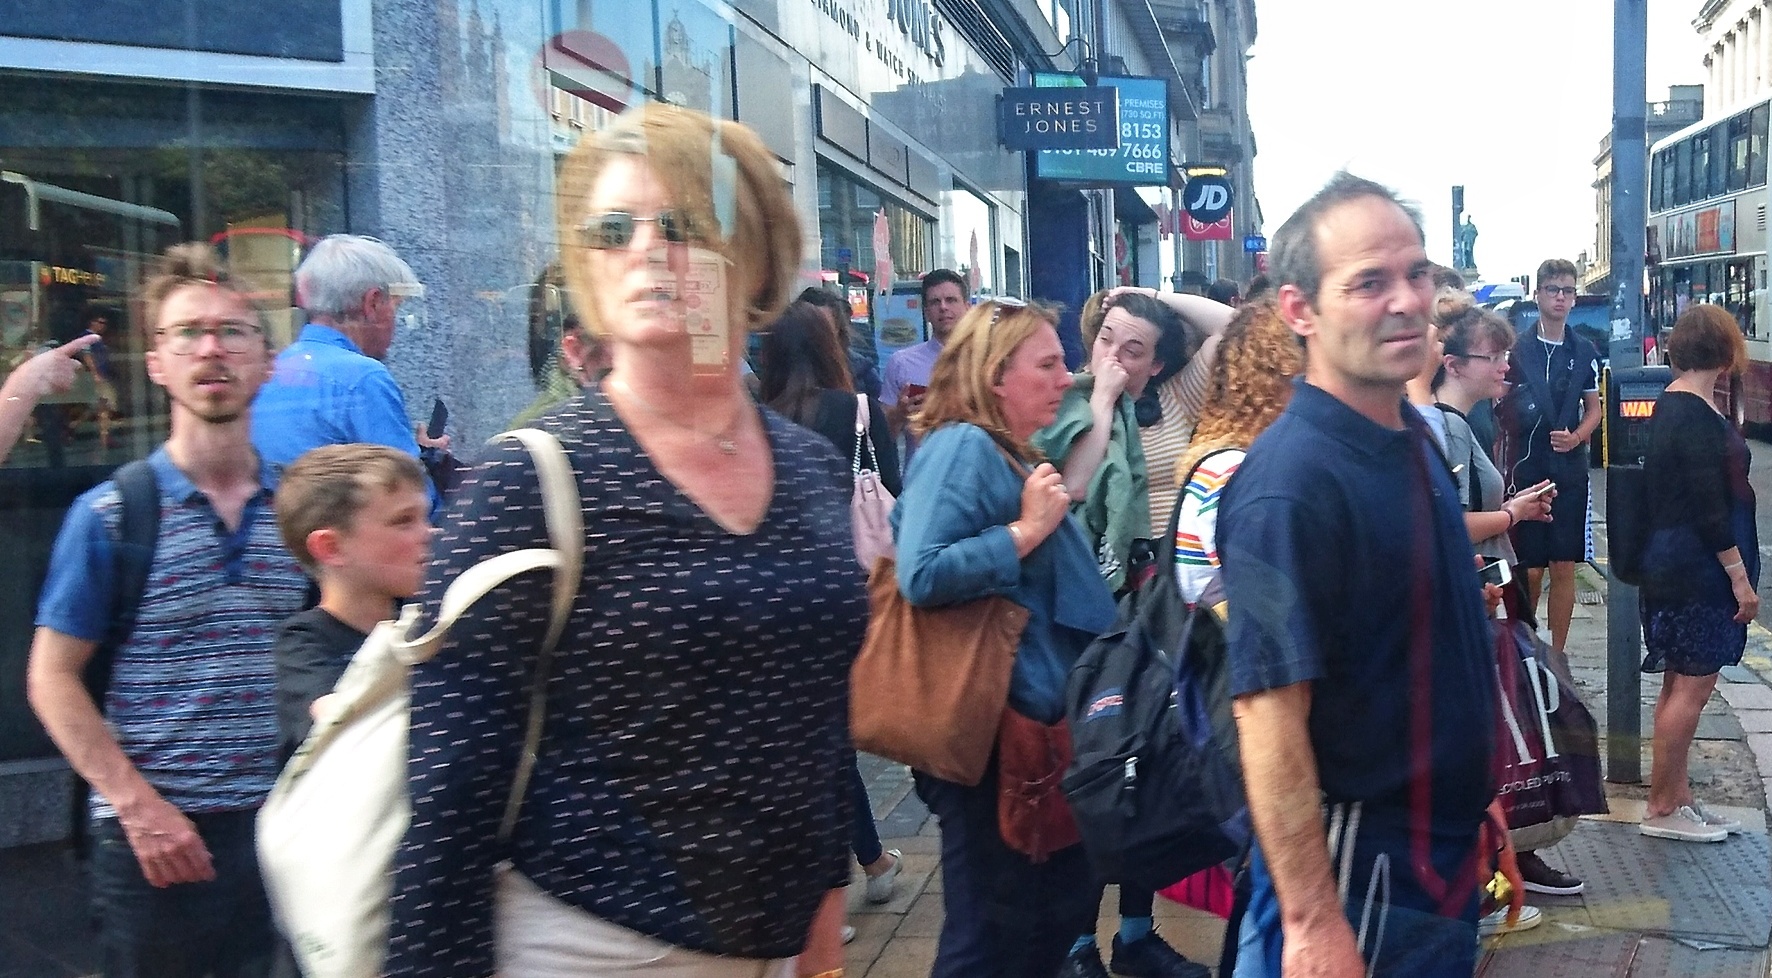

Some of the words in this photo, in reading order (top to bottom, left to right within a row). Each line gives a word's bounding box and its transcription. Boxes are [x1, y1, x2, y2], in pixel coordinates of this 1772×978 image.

[811, 0, 860, 42] AMOND
[876, 39, 904, 79] WATCH
[1015, 101, 1104, 116] ERNEST
[1124, 99, 1165, 110] PREMISES
[1024, 119, 1098, 133] JONES
[1121, 122, 1162, 139] 8153
[1121, 142, 1162, 159] 7666
[1126, 161, 1163, 174] CBRE
[1191, 184, 1228, 211] JD
